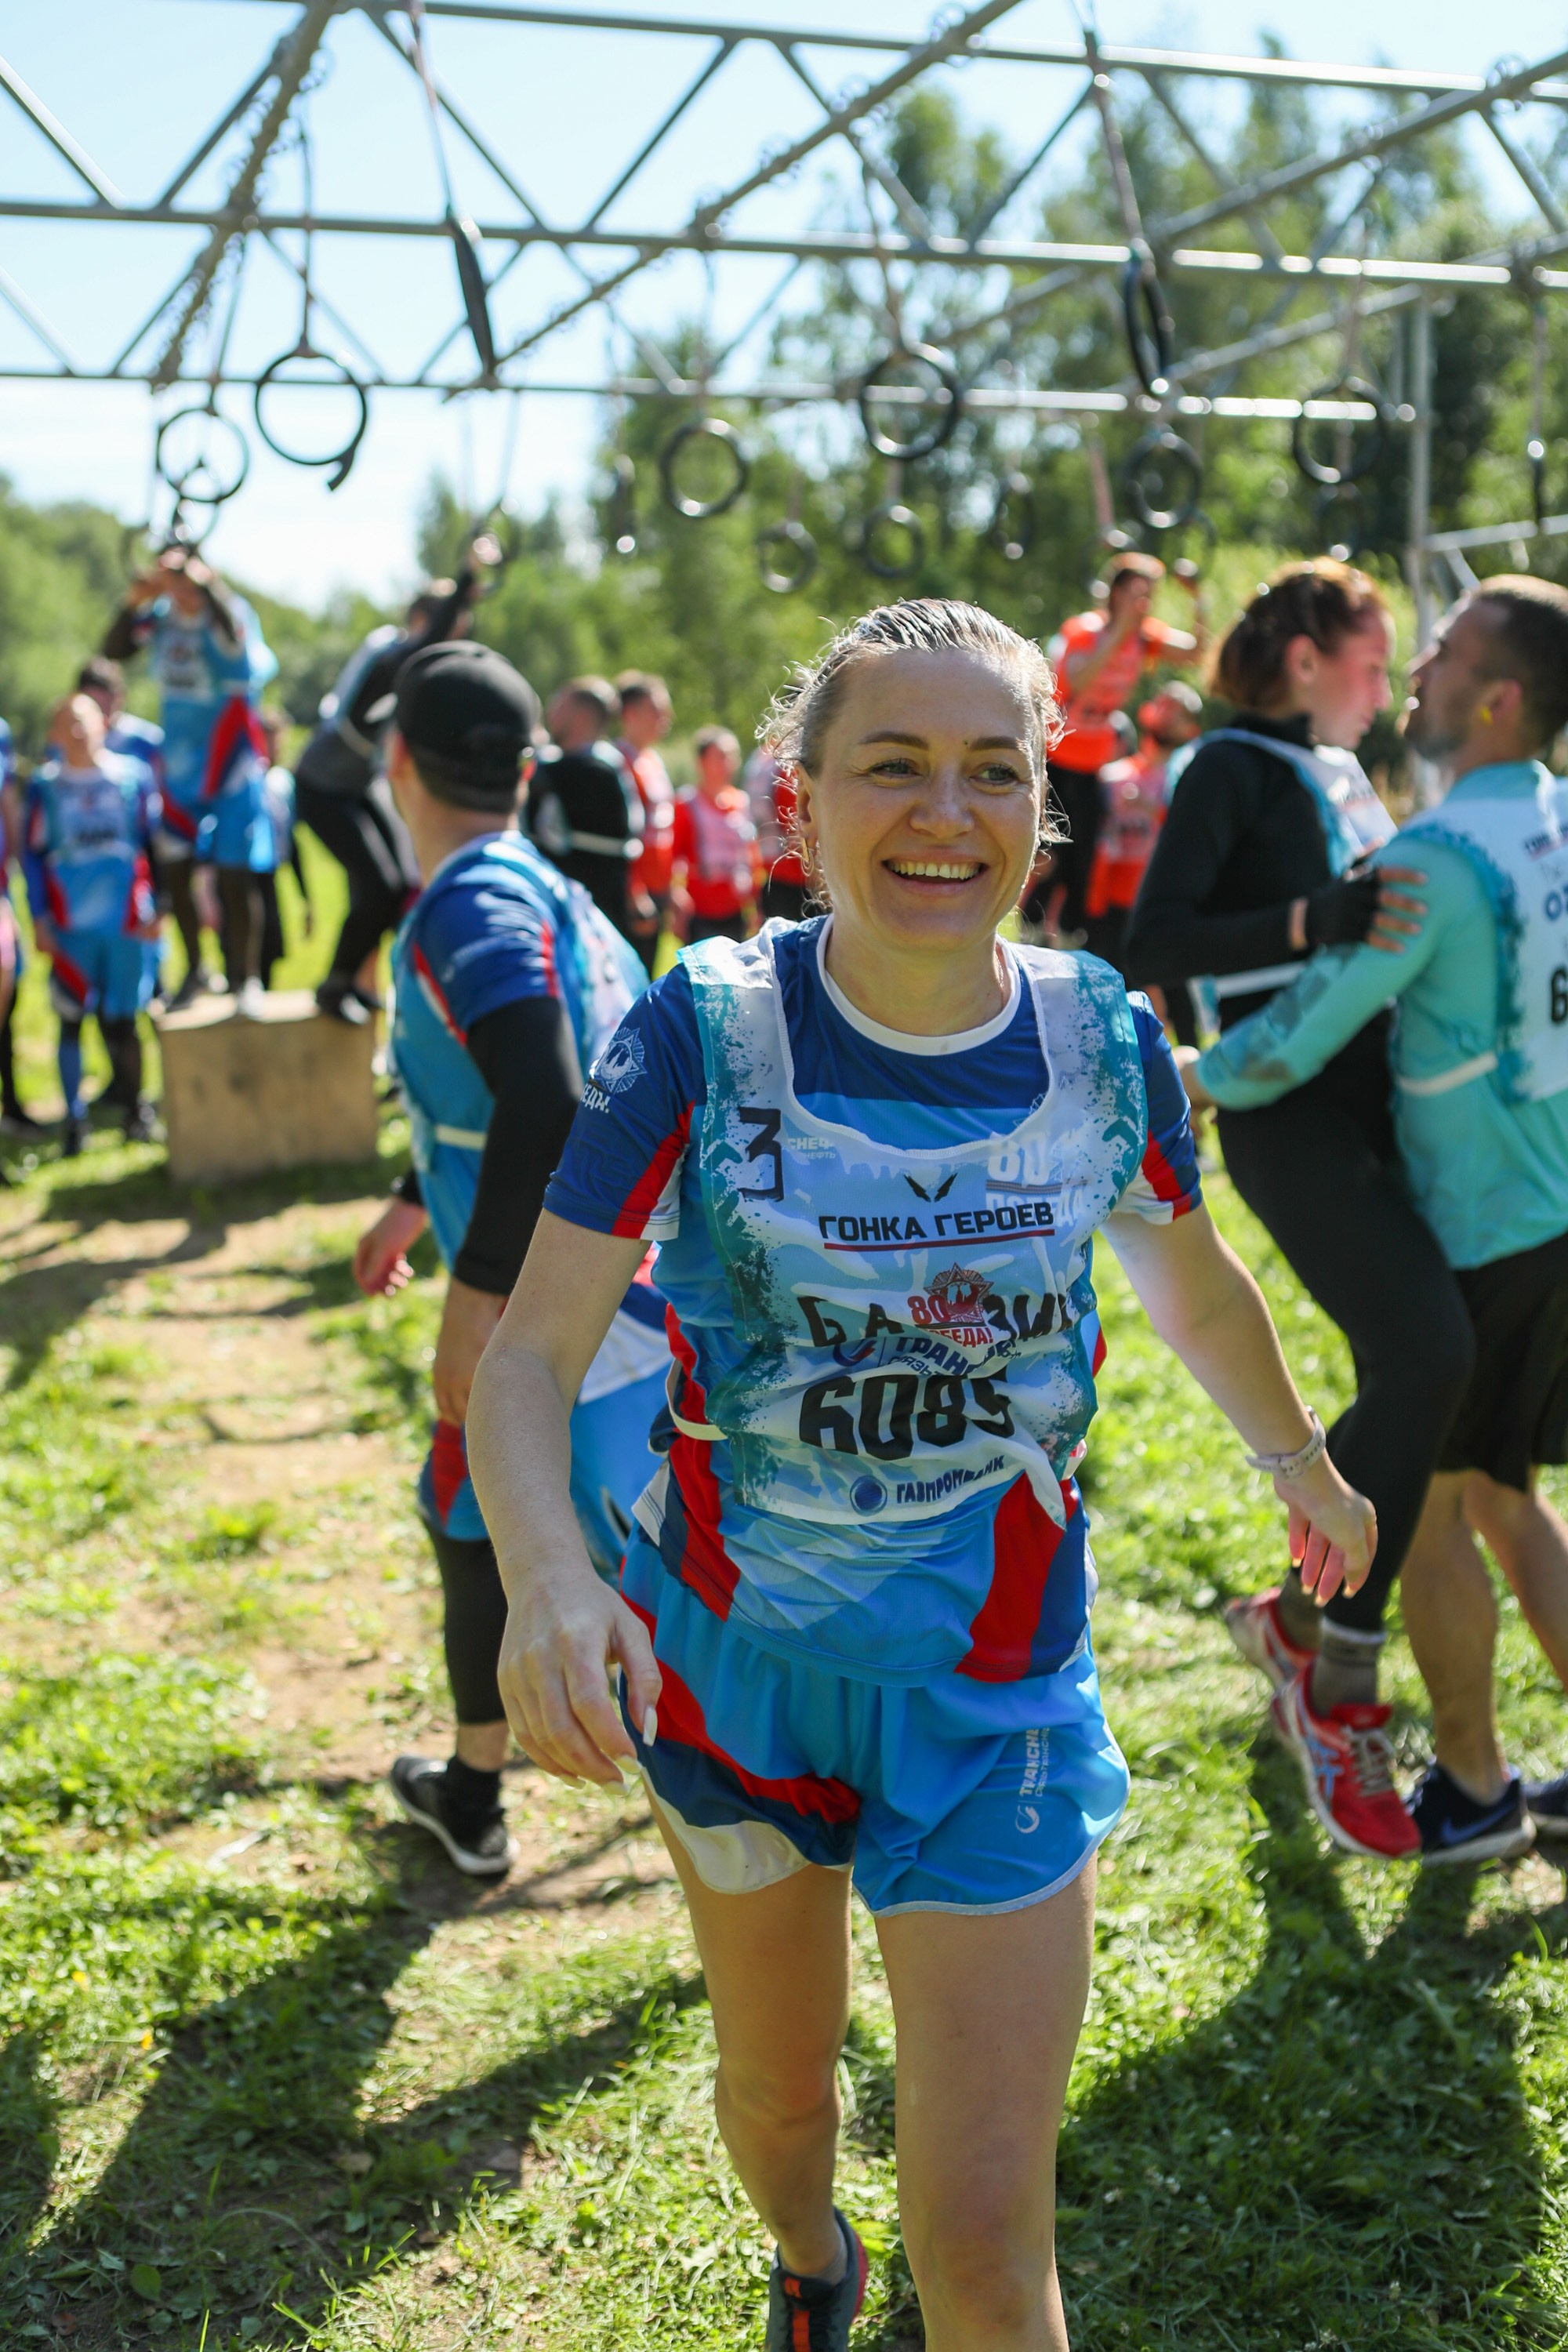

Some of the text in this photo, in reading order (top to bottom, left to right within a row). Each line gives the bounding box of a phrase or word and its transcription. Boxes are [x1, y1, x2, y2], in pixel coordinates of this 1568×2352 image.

[581, 1083, 611, 1113] ЕДА!
[818, 1202, 1054, 1241] ГОНКА ГЕРОЕВ
[907, 1294, 952, 1326] 80
[930, 1327, 994, 1348] БЕДА!
[800, 1374, 1015, 1461] 6085
